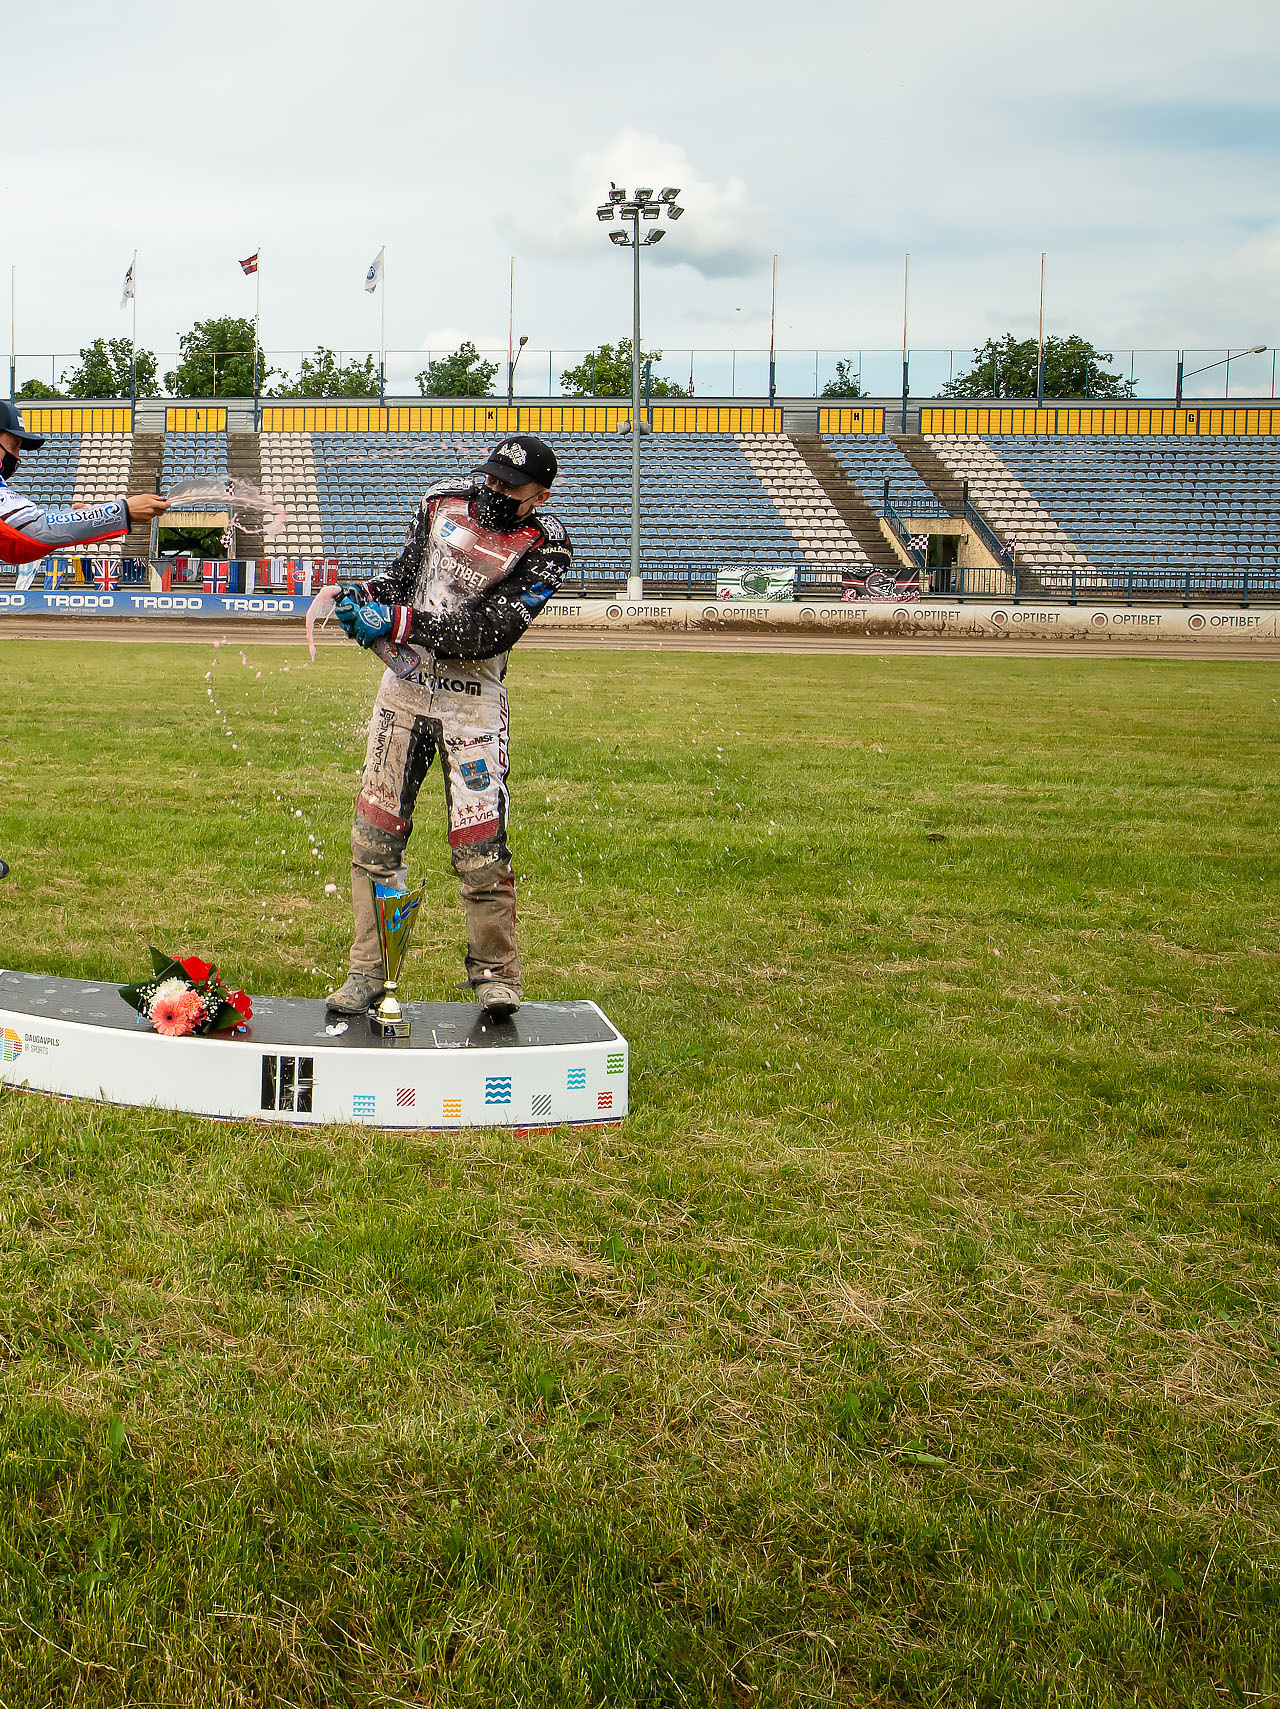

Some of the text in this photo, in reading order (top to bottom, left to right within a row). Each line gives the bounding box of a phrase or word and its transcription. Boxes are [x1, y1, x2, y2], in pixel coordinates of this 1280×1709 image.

[488, 411, 494, 420] K
[853, 412, 860, 421] H
[440, 556, 489, 588] OPTIBET
[43, 594, 115, 608] TRODO
[131, 596, 202, 610] TRODO
[221, 598, 294, 612] TRODO
[626, 606, 673, 617] OPTIBET
[722, 608, 769, 620] OPTIBET
[820, 609, 867, 620] OPTIBET
[913, 610, 961, 621] OPTIBET
[1012, 612, 1061, 624] OPTIBET
[1112, 614, 1162, 625] OPTIBET
[1210, 615, 1261, 627] OPTIBET
[453, 810, 494, 828] LATVIA
[24, 1033, 60, 1047] DAUGAVPILS
[30, 1045, 49, 1056] SPORTS
